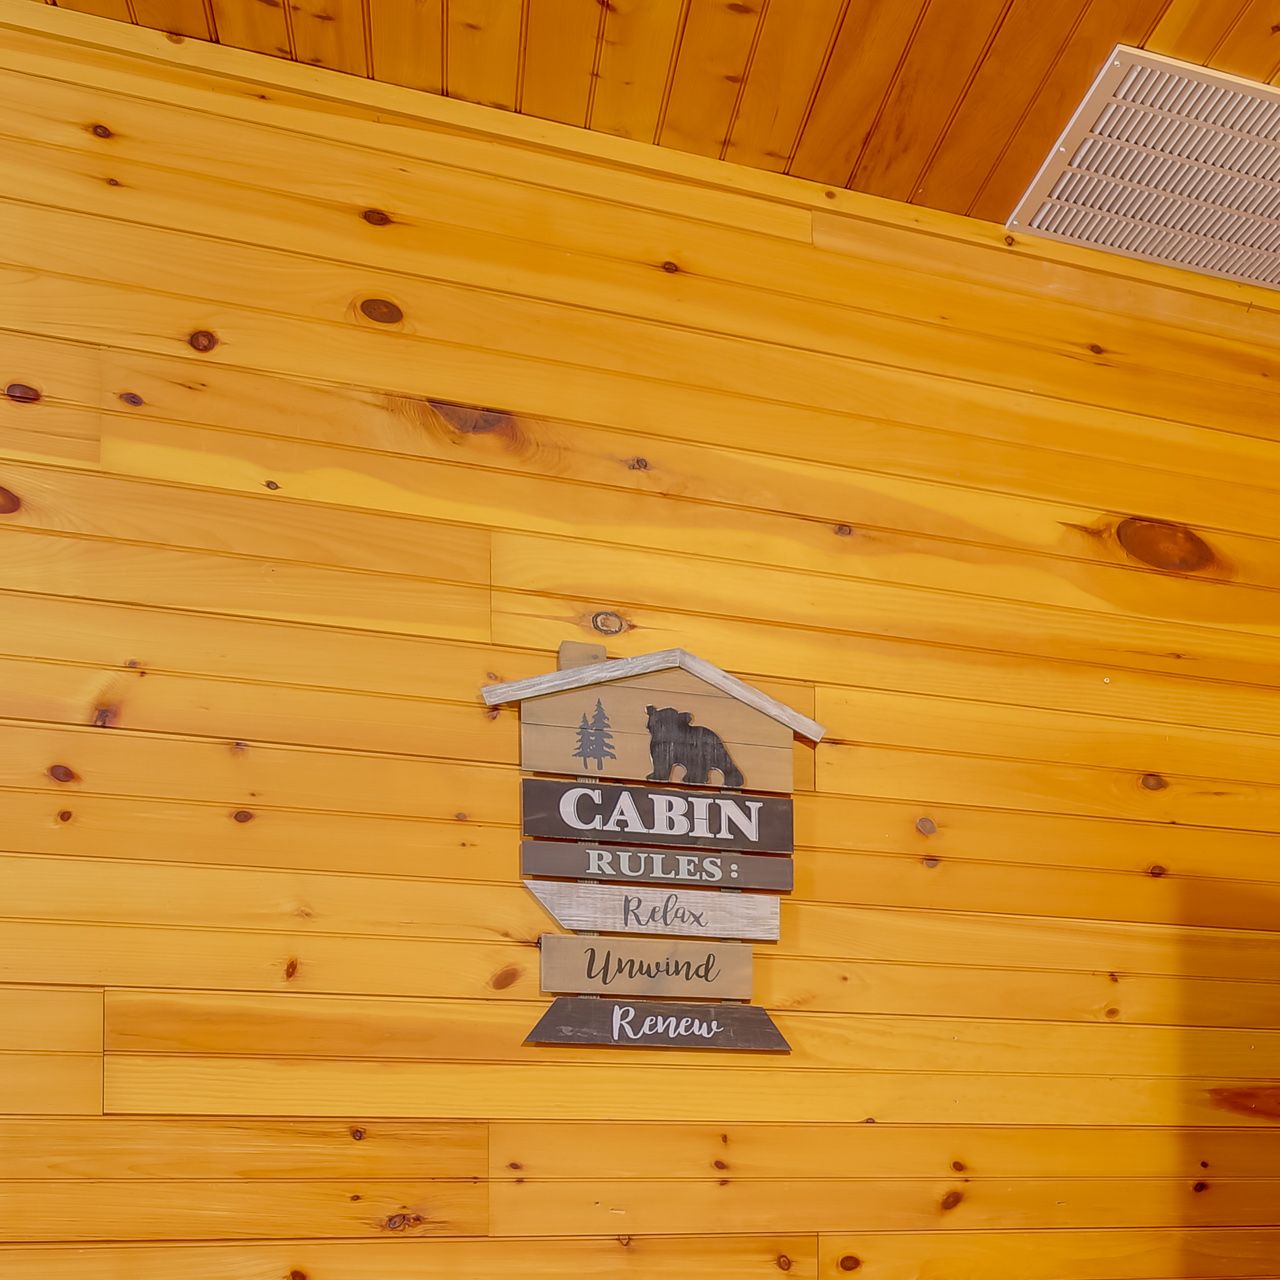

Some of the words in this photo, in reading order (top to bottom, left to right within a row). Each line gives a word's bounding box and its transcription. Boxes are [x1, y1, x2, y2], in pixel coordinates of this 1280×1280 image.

[559, 787, 764, 842] CABIN
[622, 894, 709, 928] Relax
[584, 946, 720, 985] Unwind
[611, 1004, 723, 1040] Renew
